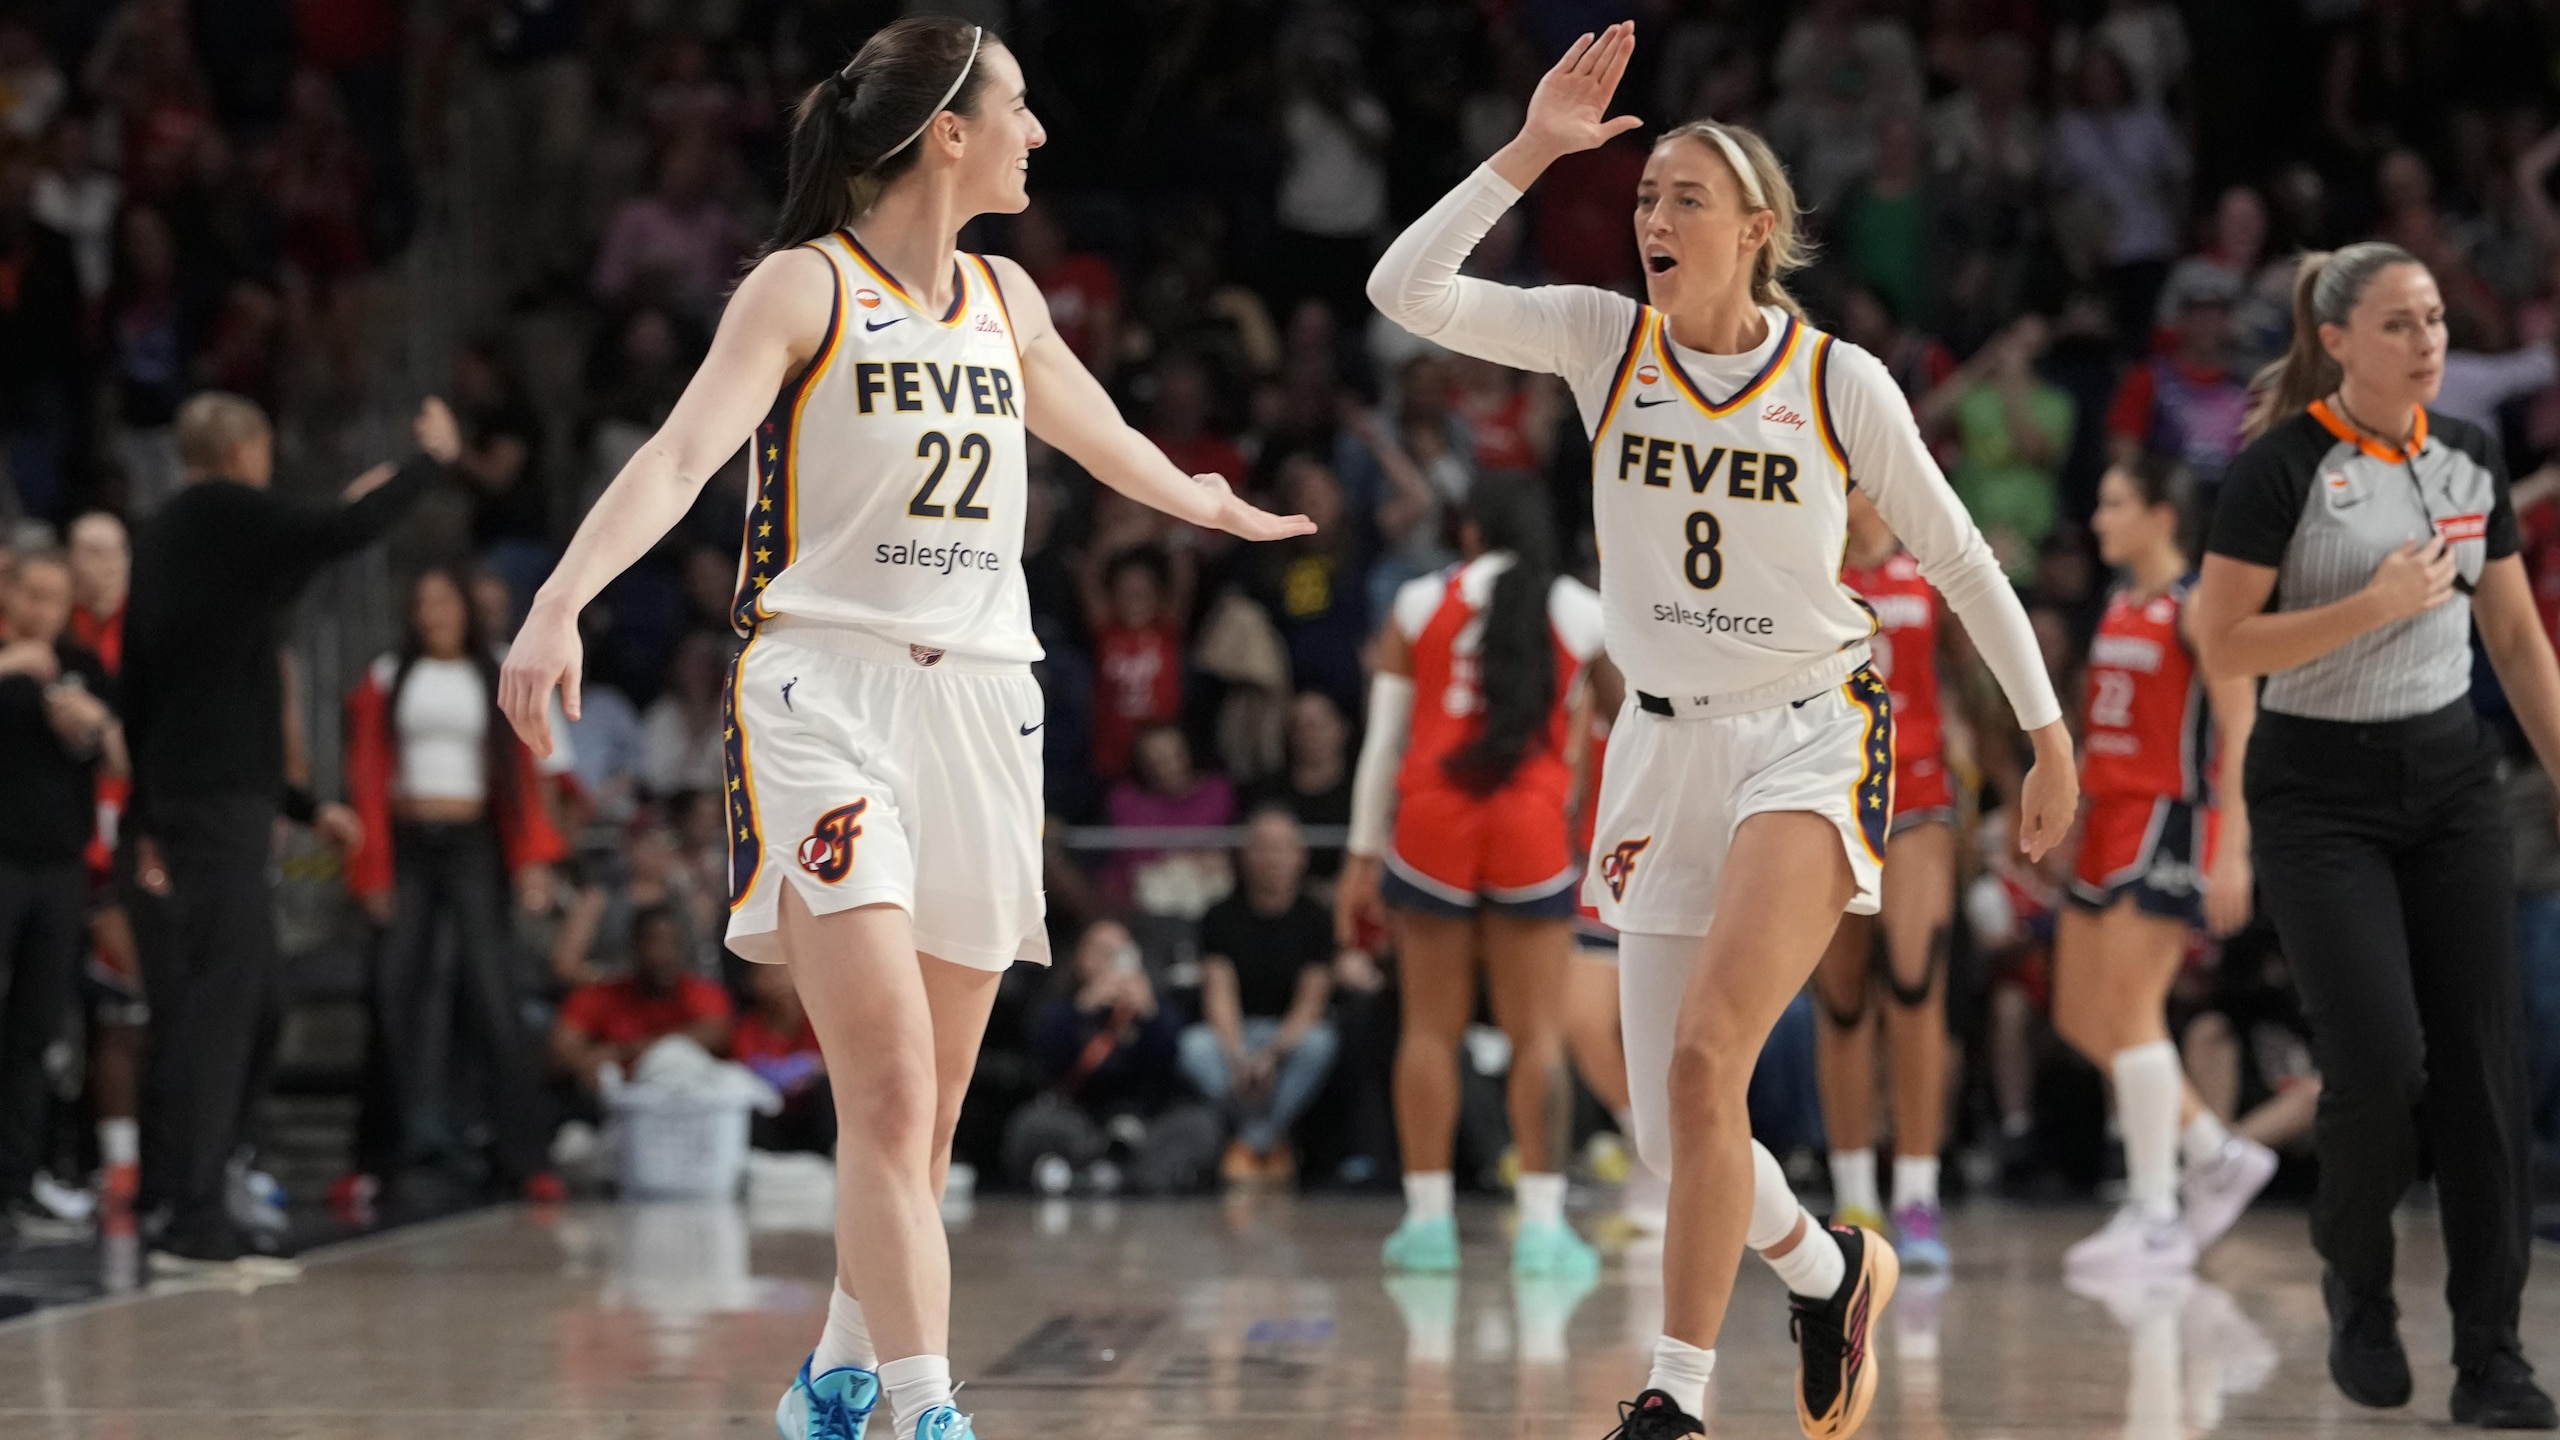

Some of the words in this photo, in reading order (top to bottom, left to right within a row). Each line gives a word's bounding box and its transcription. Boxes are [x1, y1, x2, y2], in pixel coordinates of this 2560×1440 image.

[855, 361, 1020, 419] FEVER
[1761, 404, 1807, 431] Lilly
[907, 430, 991, 521] 22
[1618, 432, 1801, 505] FEVER
[875, 539, 999, 575] salesforce
[1683, 510, 1723, 590] 8
[1653, 601, 1774, 635] salesforce
